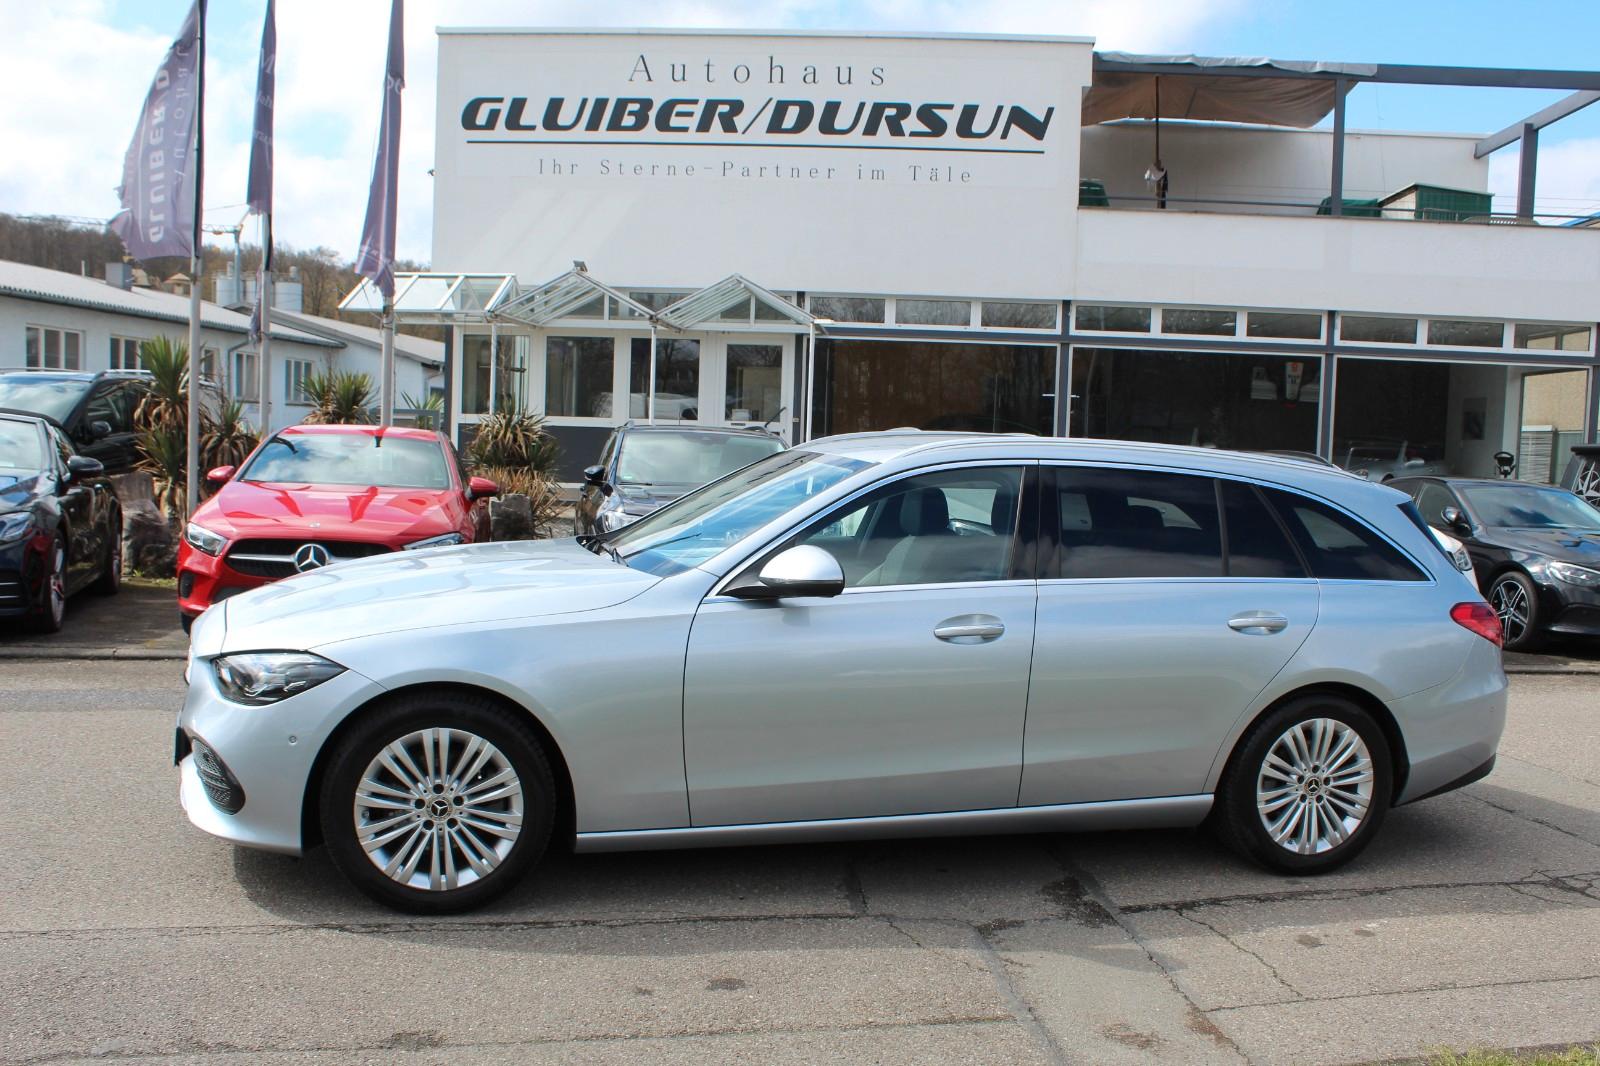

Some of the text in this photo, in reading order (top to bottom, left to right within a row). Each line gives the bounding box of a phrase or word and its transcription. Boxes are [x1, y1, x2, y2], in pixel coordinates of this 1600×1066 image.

[628, 54, 885, 86] Autohaus
[461, 96, 1056, 142] GLUIBER/DURSUN
[538, 158, 972, 183] Ihr Sterne-Partner im Täle
